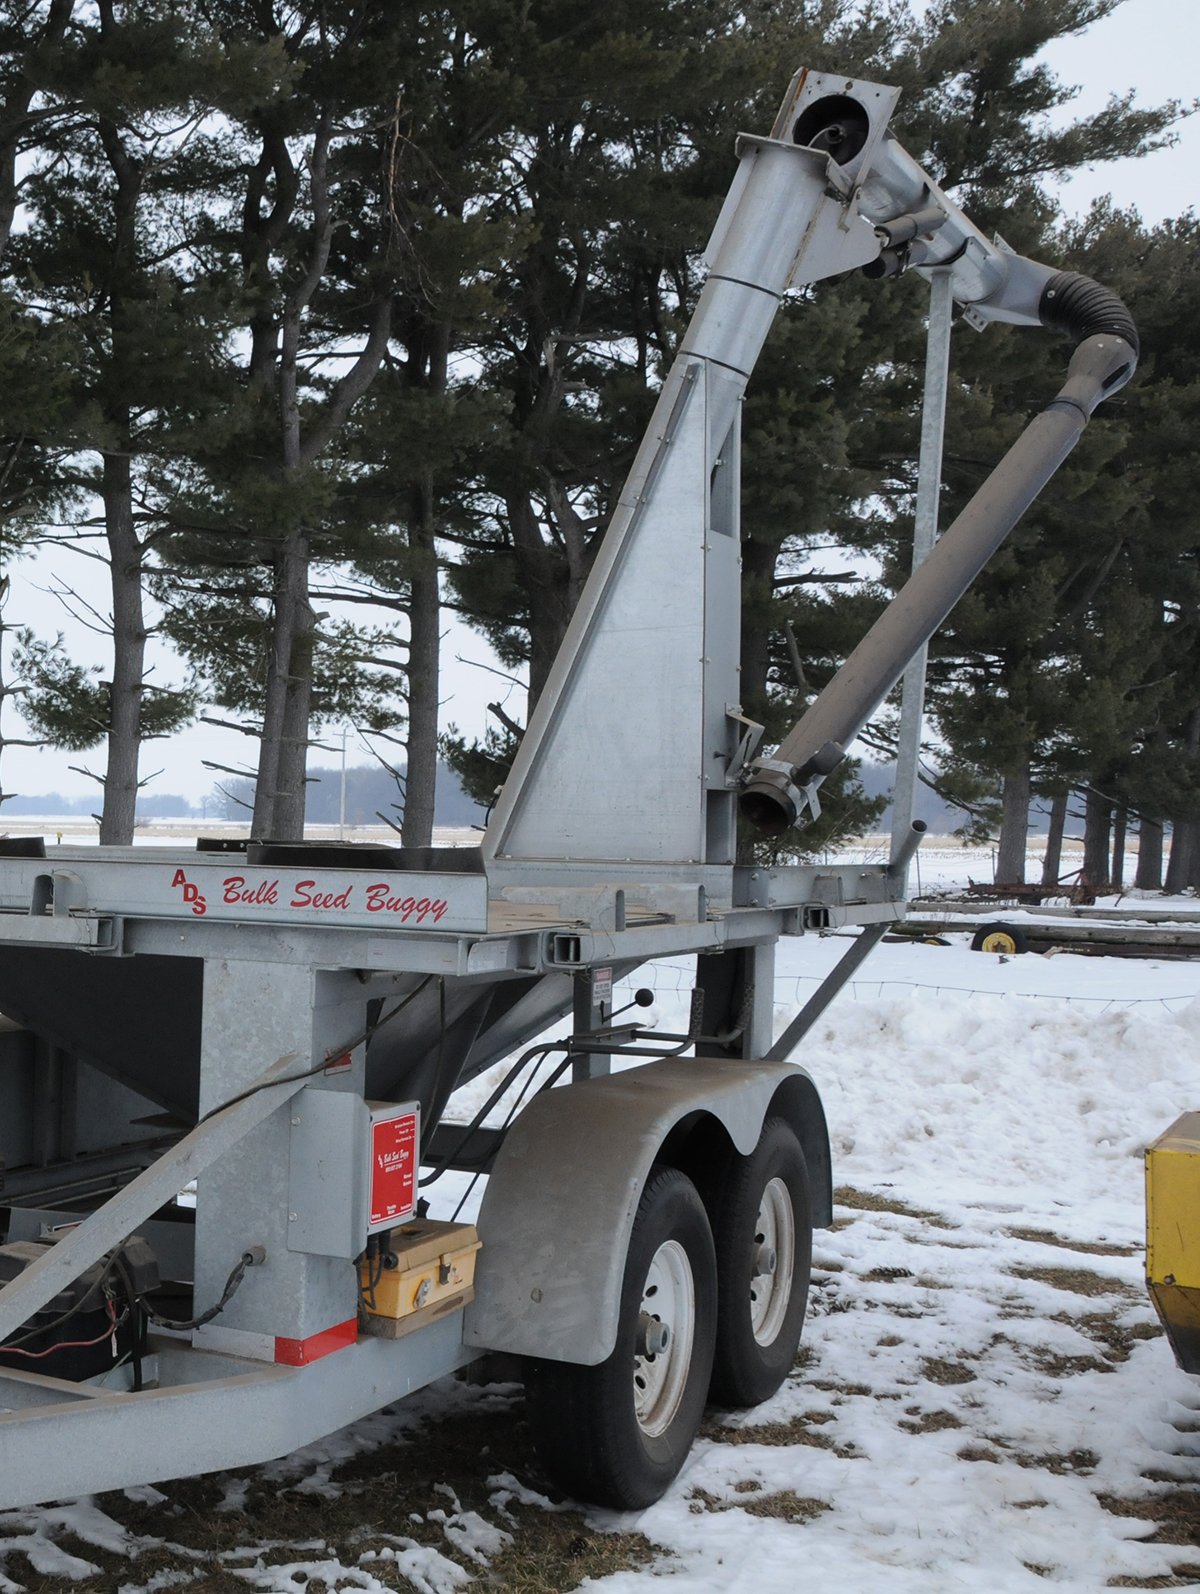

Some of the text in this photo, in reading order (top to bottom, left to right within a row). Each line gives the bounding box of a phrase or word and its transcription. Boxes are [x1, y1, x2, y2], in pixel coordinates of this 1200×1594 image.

[171, 869, 207, 915] ADS
[222, 876, 448, 923] Bulk Seed Buggy
